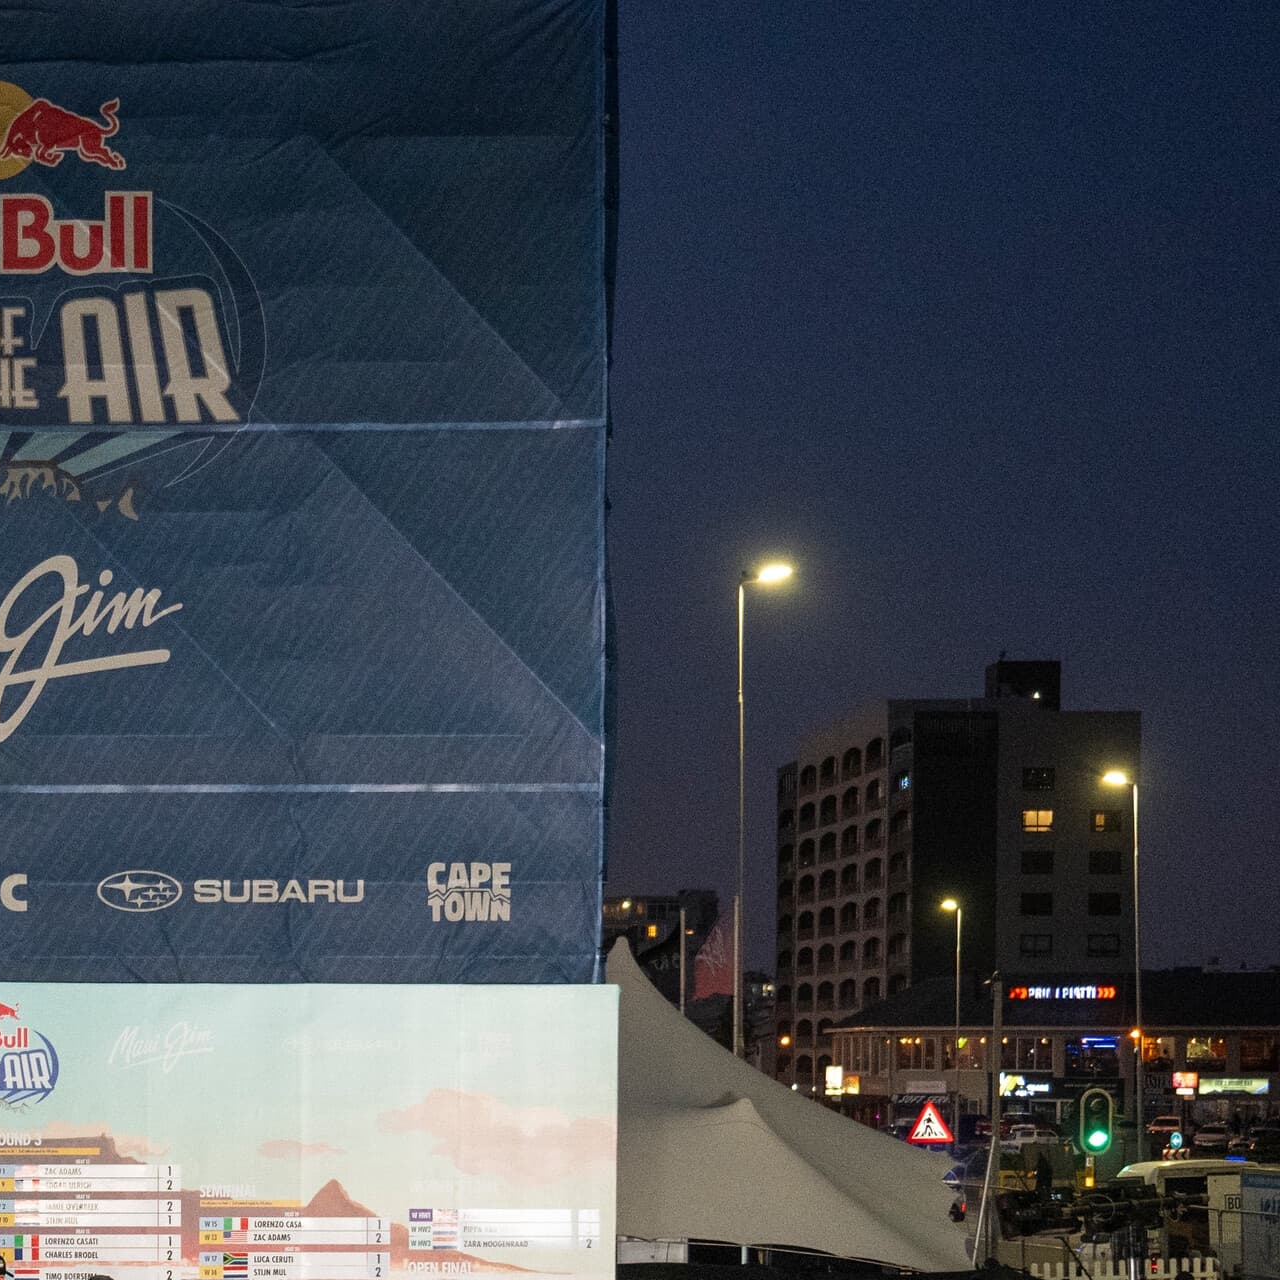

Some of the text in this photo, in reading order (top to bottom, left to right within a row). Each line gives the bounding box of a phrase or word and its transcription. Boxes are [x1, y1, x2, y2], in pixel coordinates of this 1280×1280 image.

[59, 288, 240, 424] AIR
[427, 862, 512, 891] CAPE
[194, 879, 364, 904] SUBARU
[429, 893, 512, 922] TOWN
[109, 1024, 215, 1073] Maui Jim
[5, 1050, 53, 1088] AIR
[36, 1134, 42, 1145] 3
[408, 1262, 439, 1273] OPEN
